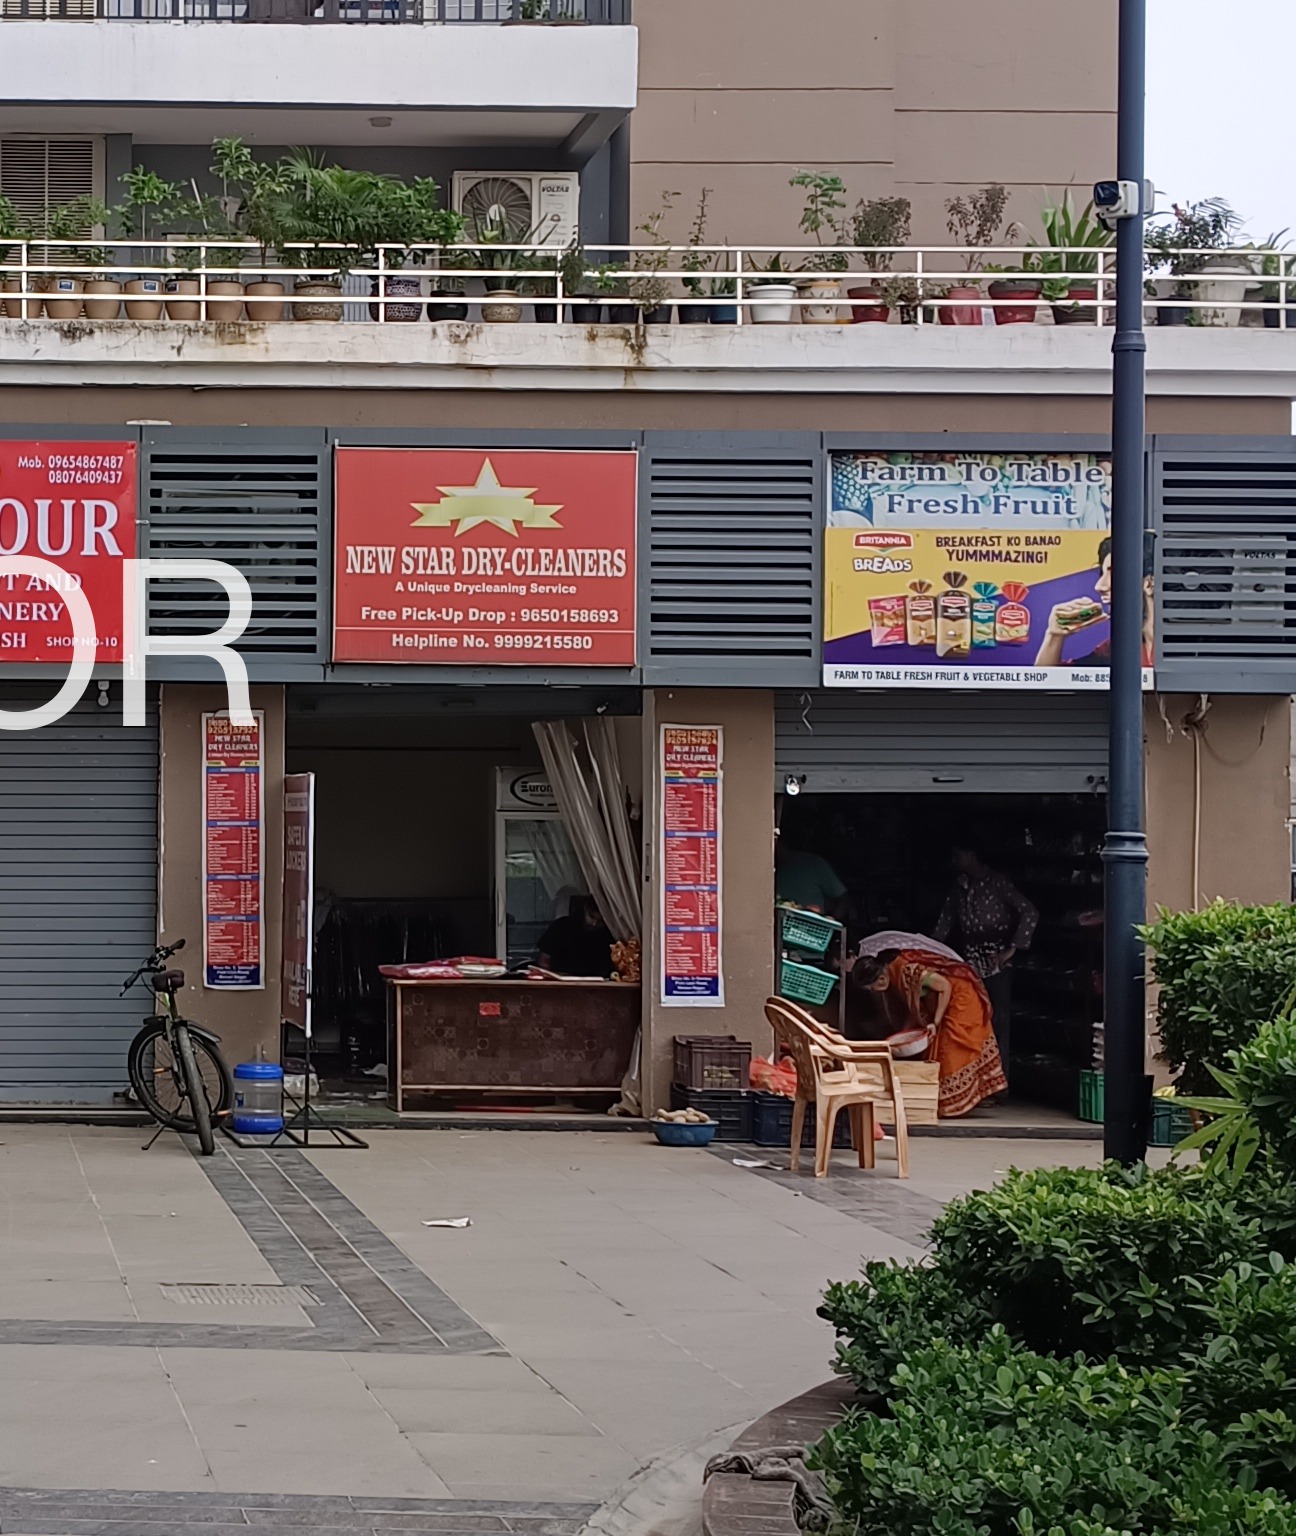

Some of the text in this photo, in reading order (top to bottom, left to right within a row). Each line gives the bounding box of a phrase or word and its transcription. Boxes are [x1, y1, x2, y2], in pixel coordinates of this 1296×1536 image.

[18, 454, 124, 469] Mob. 09654867487
[48, 470, 123, 484] 08076409437
[858, 460, 1104, 484] Farm To Table
[886, 493, 1078, 516] Fresh Fruit
[859, 536, 907, 545] BRITANNIA
[936, 535, 1062, 548] BREAKFAST KO BANAO
[345, 545, 627, 578] NEW STAR DRY-CLEANERS
[945, 549, 1048, 564] YUMMMAZING!
[853, 557, 912, 573] BREADS
[26, 572, 82, 592] AND
[395, 582, 577, 596] A Unique Drycleaning Service
[361, 607, 397, 621] Free
[402, 607, 464, 624] Pick-Up
[468, 608, 506, 624] Drop
[520, 608, 619, 624] 9650158693
[46, 636, 78, 647] SHOP
[392, 634, 593, 650] Helpline No. 9999215580
[834, 670, 859, 680] FARM
[862, 670, 873, 680] TO
[876, 671, 901, 681] TABLE
[904, 671, 933, 681] FRESH
[935, 672, 960, 681] FRUIT
[972, 672, 1020, 682] VEGETABLE
[1024, 672, 1048, 682] SHOP
[208, 743, 223, 751] DRY
